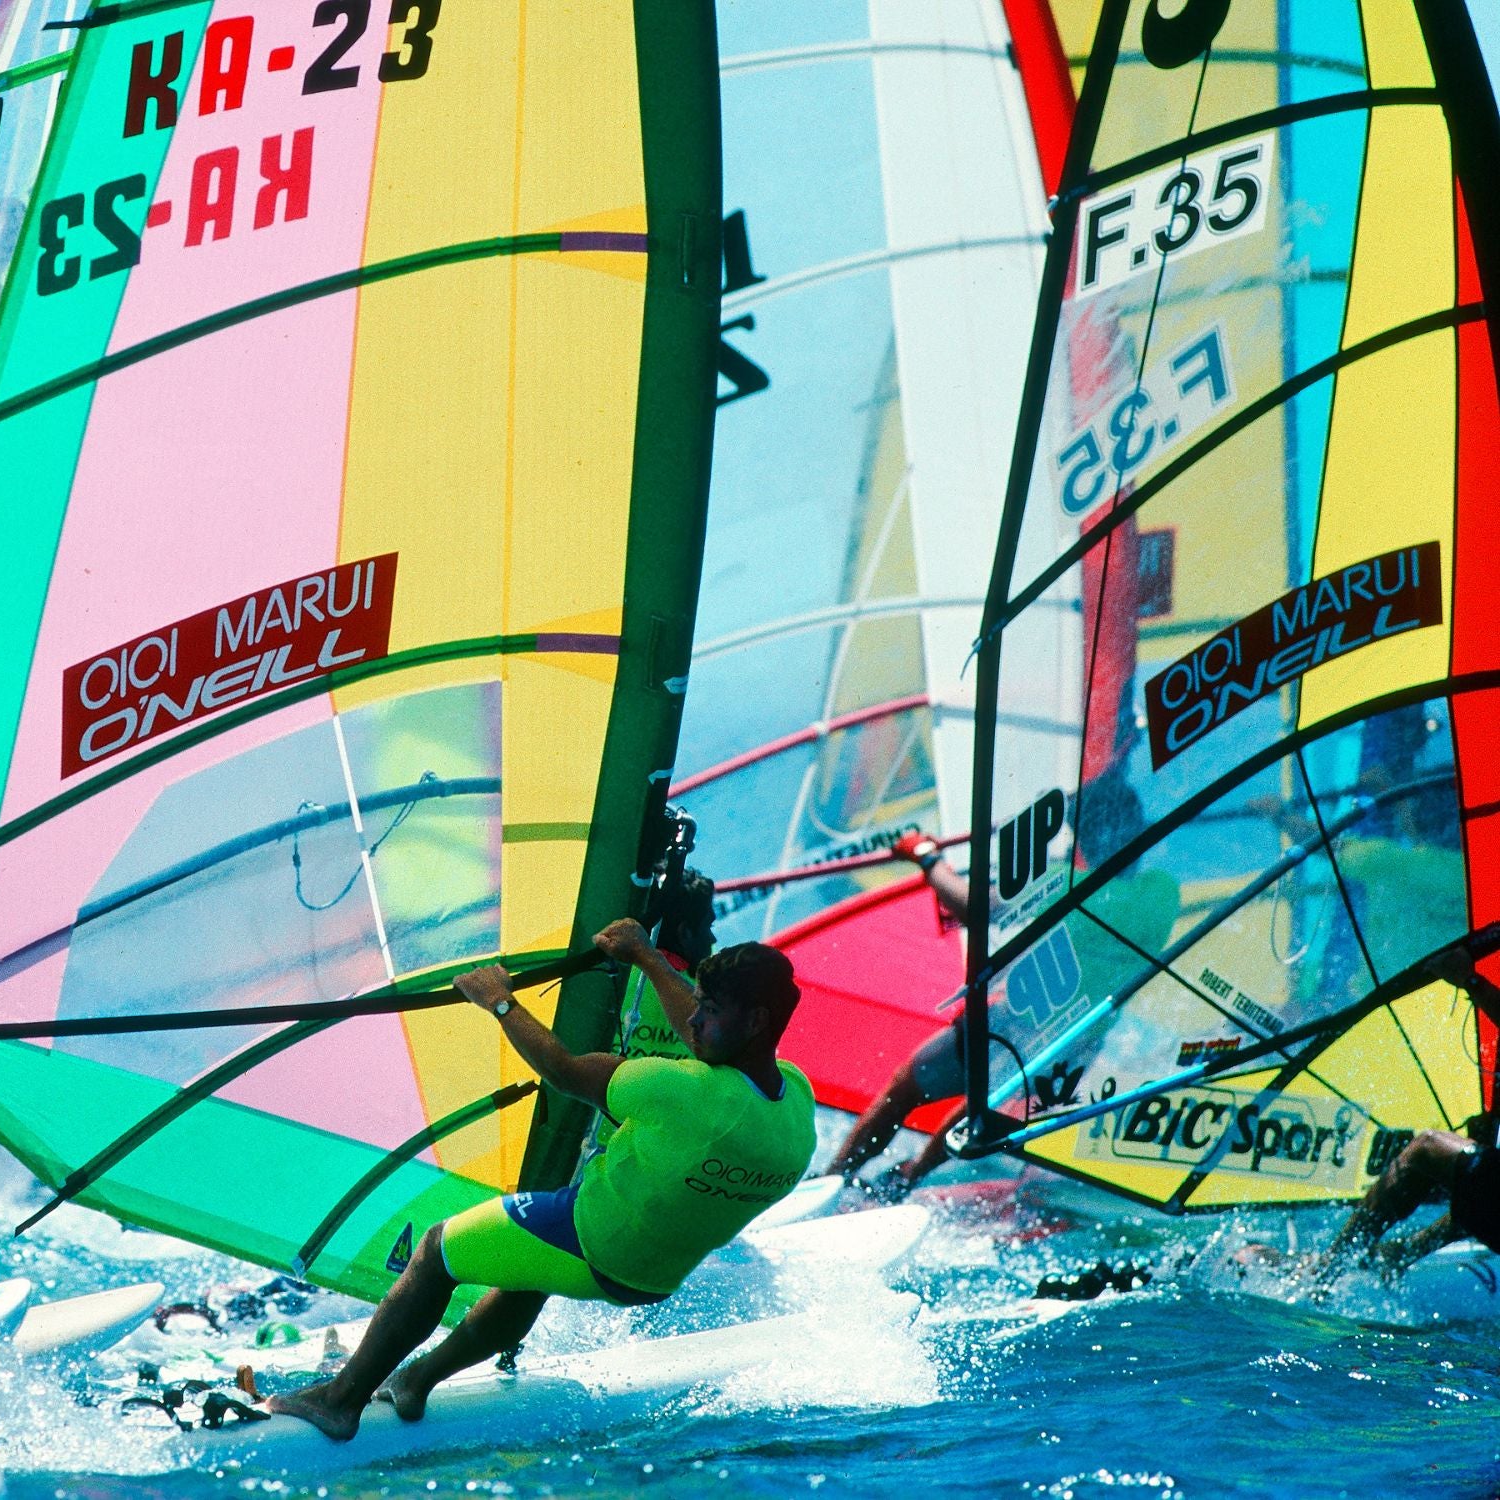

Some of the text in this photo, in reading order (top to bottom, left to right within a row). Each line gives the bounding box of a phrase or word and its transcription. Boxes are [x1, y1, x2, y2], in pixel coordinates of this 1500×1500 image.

[123, 0, 443, 139] KA-23
[1082, 146, 1261, 290] F.35
[215, 560, 375, 658] MARUI
[1272, 548, 1420, 644] MARUI
[79, 628, 366, 762] O'NEILL
[1165, 603, 1420, 752] O'NEILL
[999, 788, 1065, 901] UP
[1232, 1101, 1350, 1172] Sport
